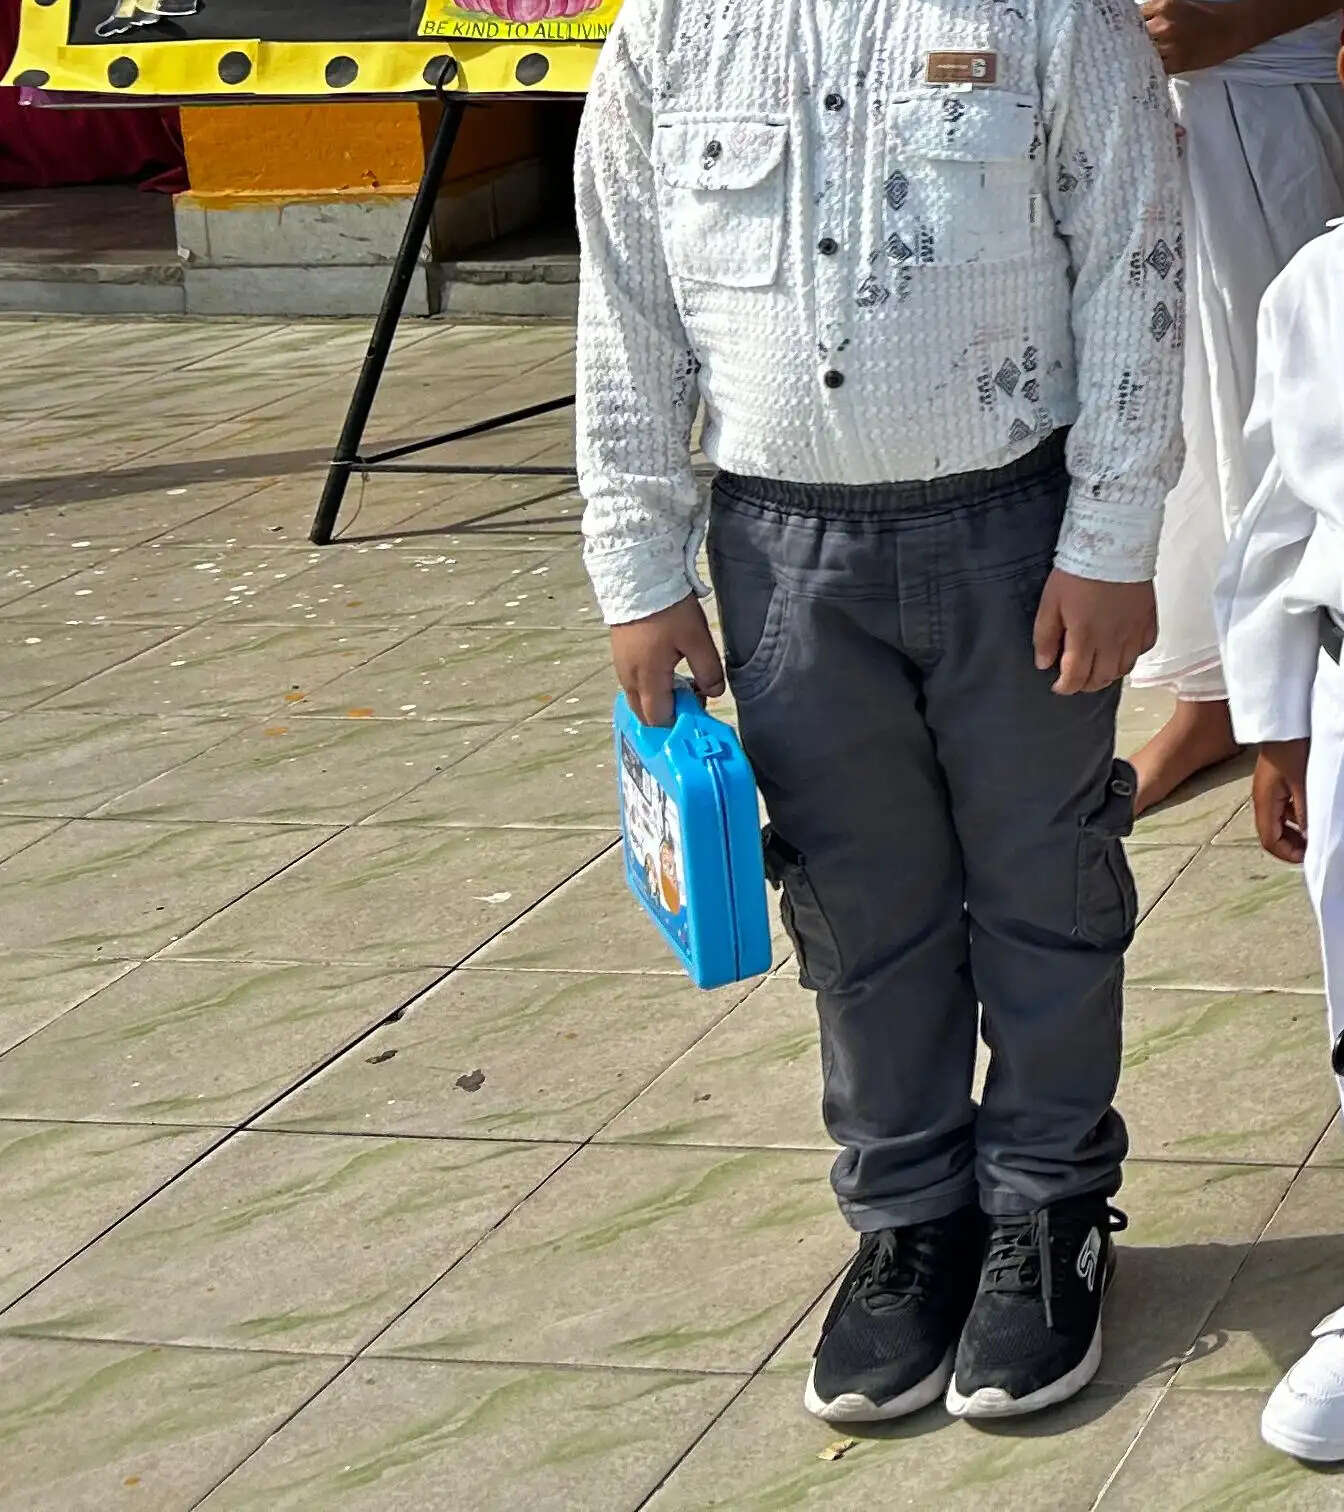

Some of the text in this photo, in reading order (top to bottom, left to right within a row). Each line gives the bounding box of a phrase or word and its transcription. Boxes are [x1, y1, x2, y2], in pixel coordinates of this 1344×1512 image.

[423, 20, 451, 35] BE
[453, 21, 499, 38] KIND
[506, 22, 529, 38] TO
